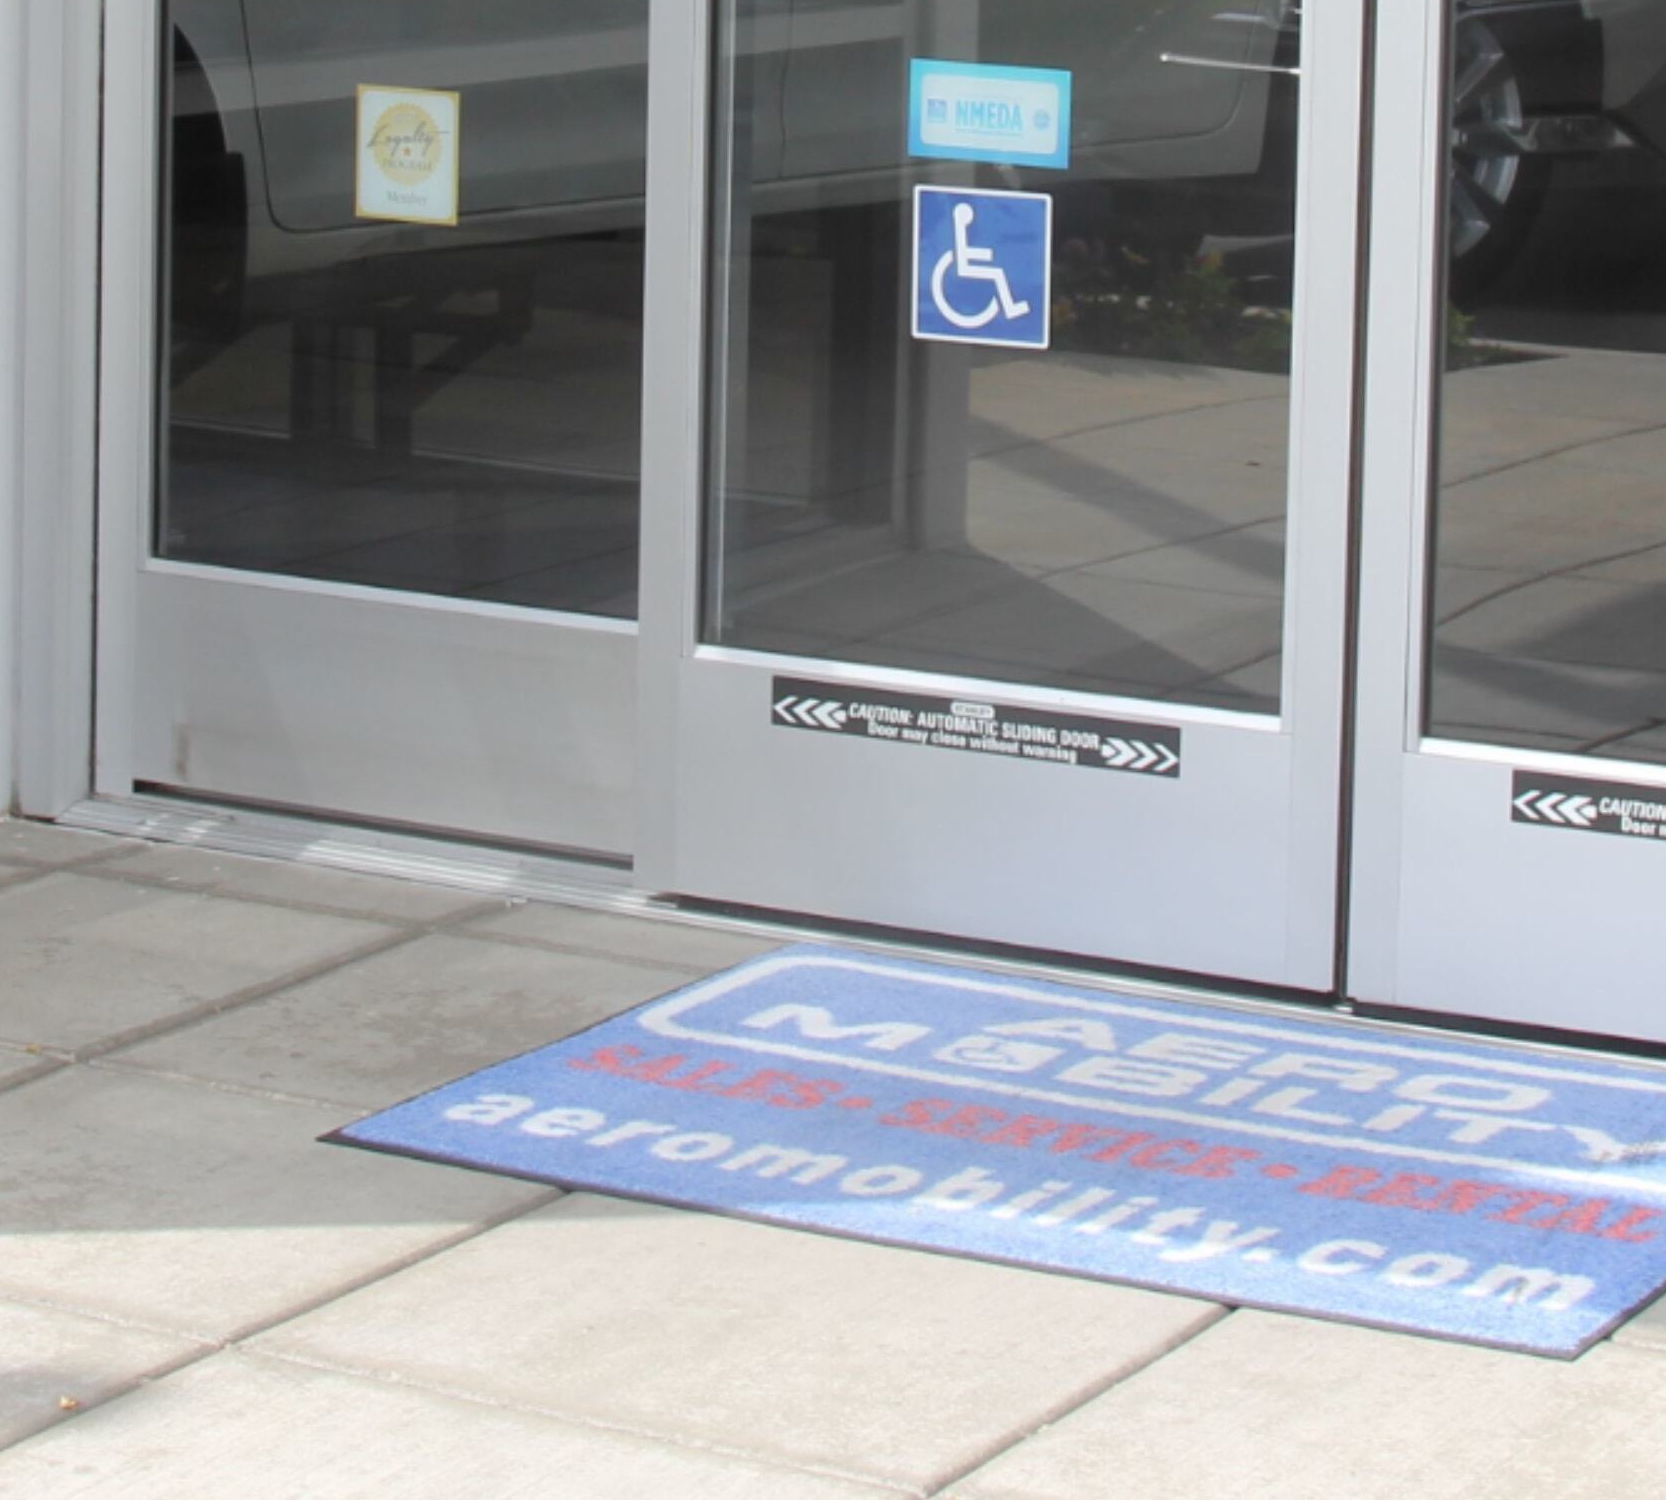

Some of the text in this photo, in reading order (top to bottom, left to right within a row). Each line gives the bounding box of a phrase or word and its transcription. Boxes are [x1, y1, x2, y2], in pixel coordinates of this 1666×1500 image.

[955, 99, 1023, 130] NMEDA
[849, 703, 1100, 749] CAUTION: AUTOMATIC SLIDING DOOR
[867, 722, 899, 739] Door
[902, 728, 928, 745] may
[969, 736, 1020, 753] without
[1023, 744, 1078, 763] warning
[1620, 818, 1657, 835] Door
[985, 1016, 1553, 1112] AERO
[442, 1088, 1599, 1312] aeromobility.com
